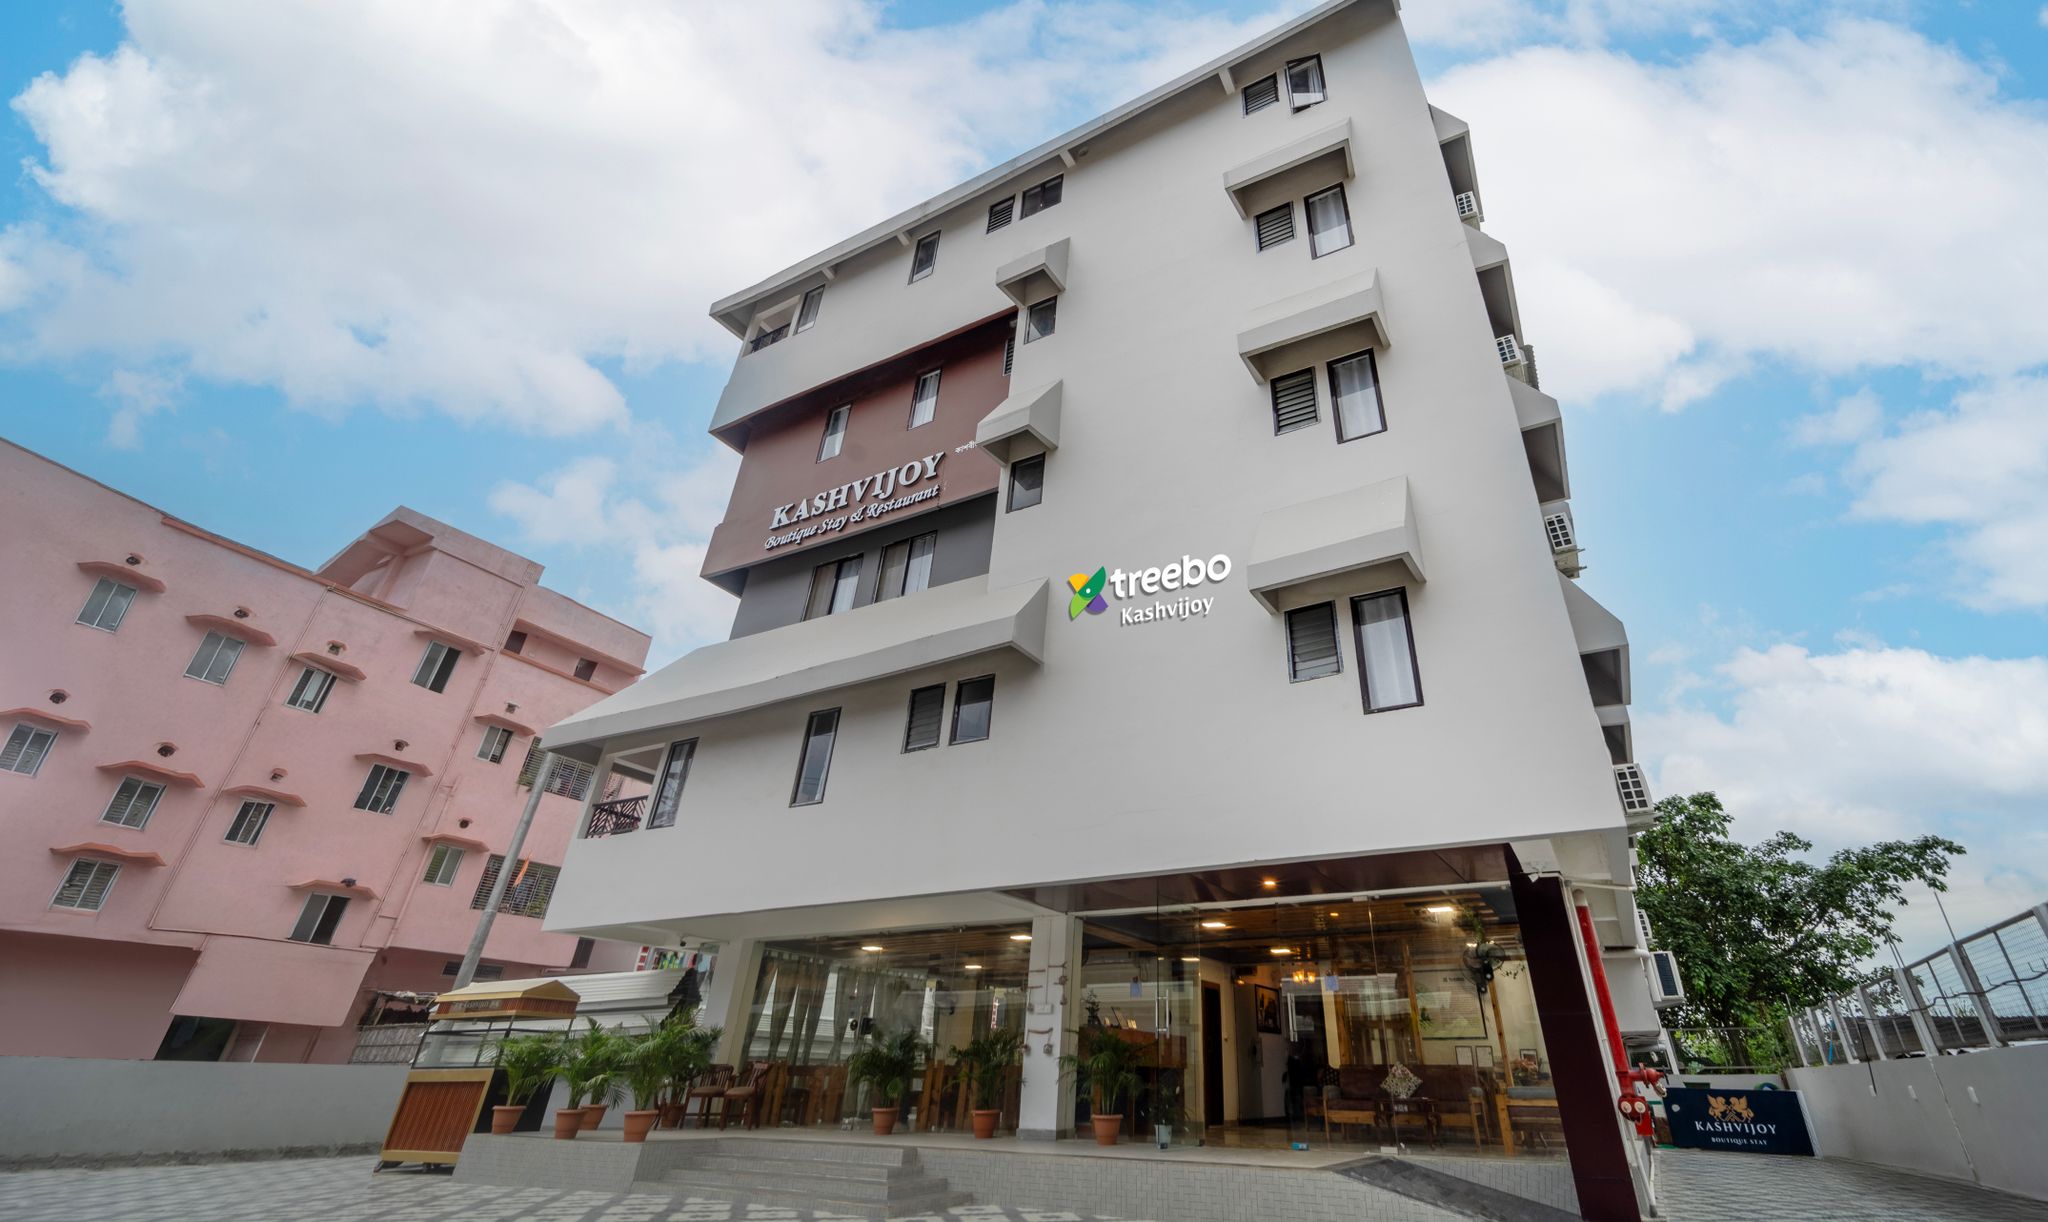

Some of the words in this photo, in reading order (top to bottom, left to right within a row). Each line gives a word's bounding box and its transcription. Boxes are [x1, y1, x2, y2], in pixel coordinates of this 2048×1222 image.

[769, 451, 945, 530] KASHVIJOY
[764, 524, 817, 549] Boutique
[818, 514, 848, 534] Stay
[850, 505, 865, 523] &
[867, 484, 940, 518] Restaurant
[1110, 554, 1232, 598] treebo
[1121, 596, 1215, 625] Kashvijoy
[1695, 1120, 1776, 1135] KASHVIJOY
[1711, 1137, 1748, 1145] BOUTIQUE
